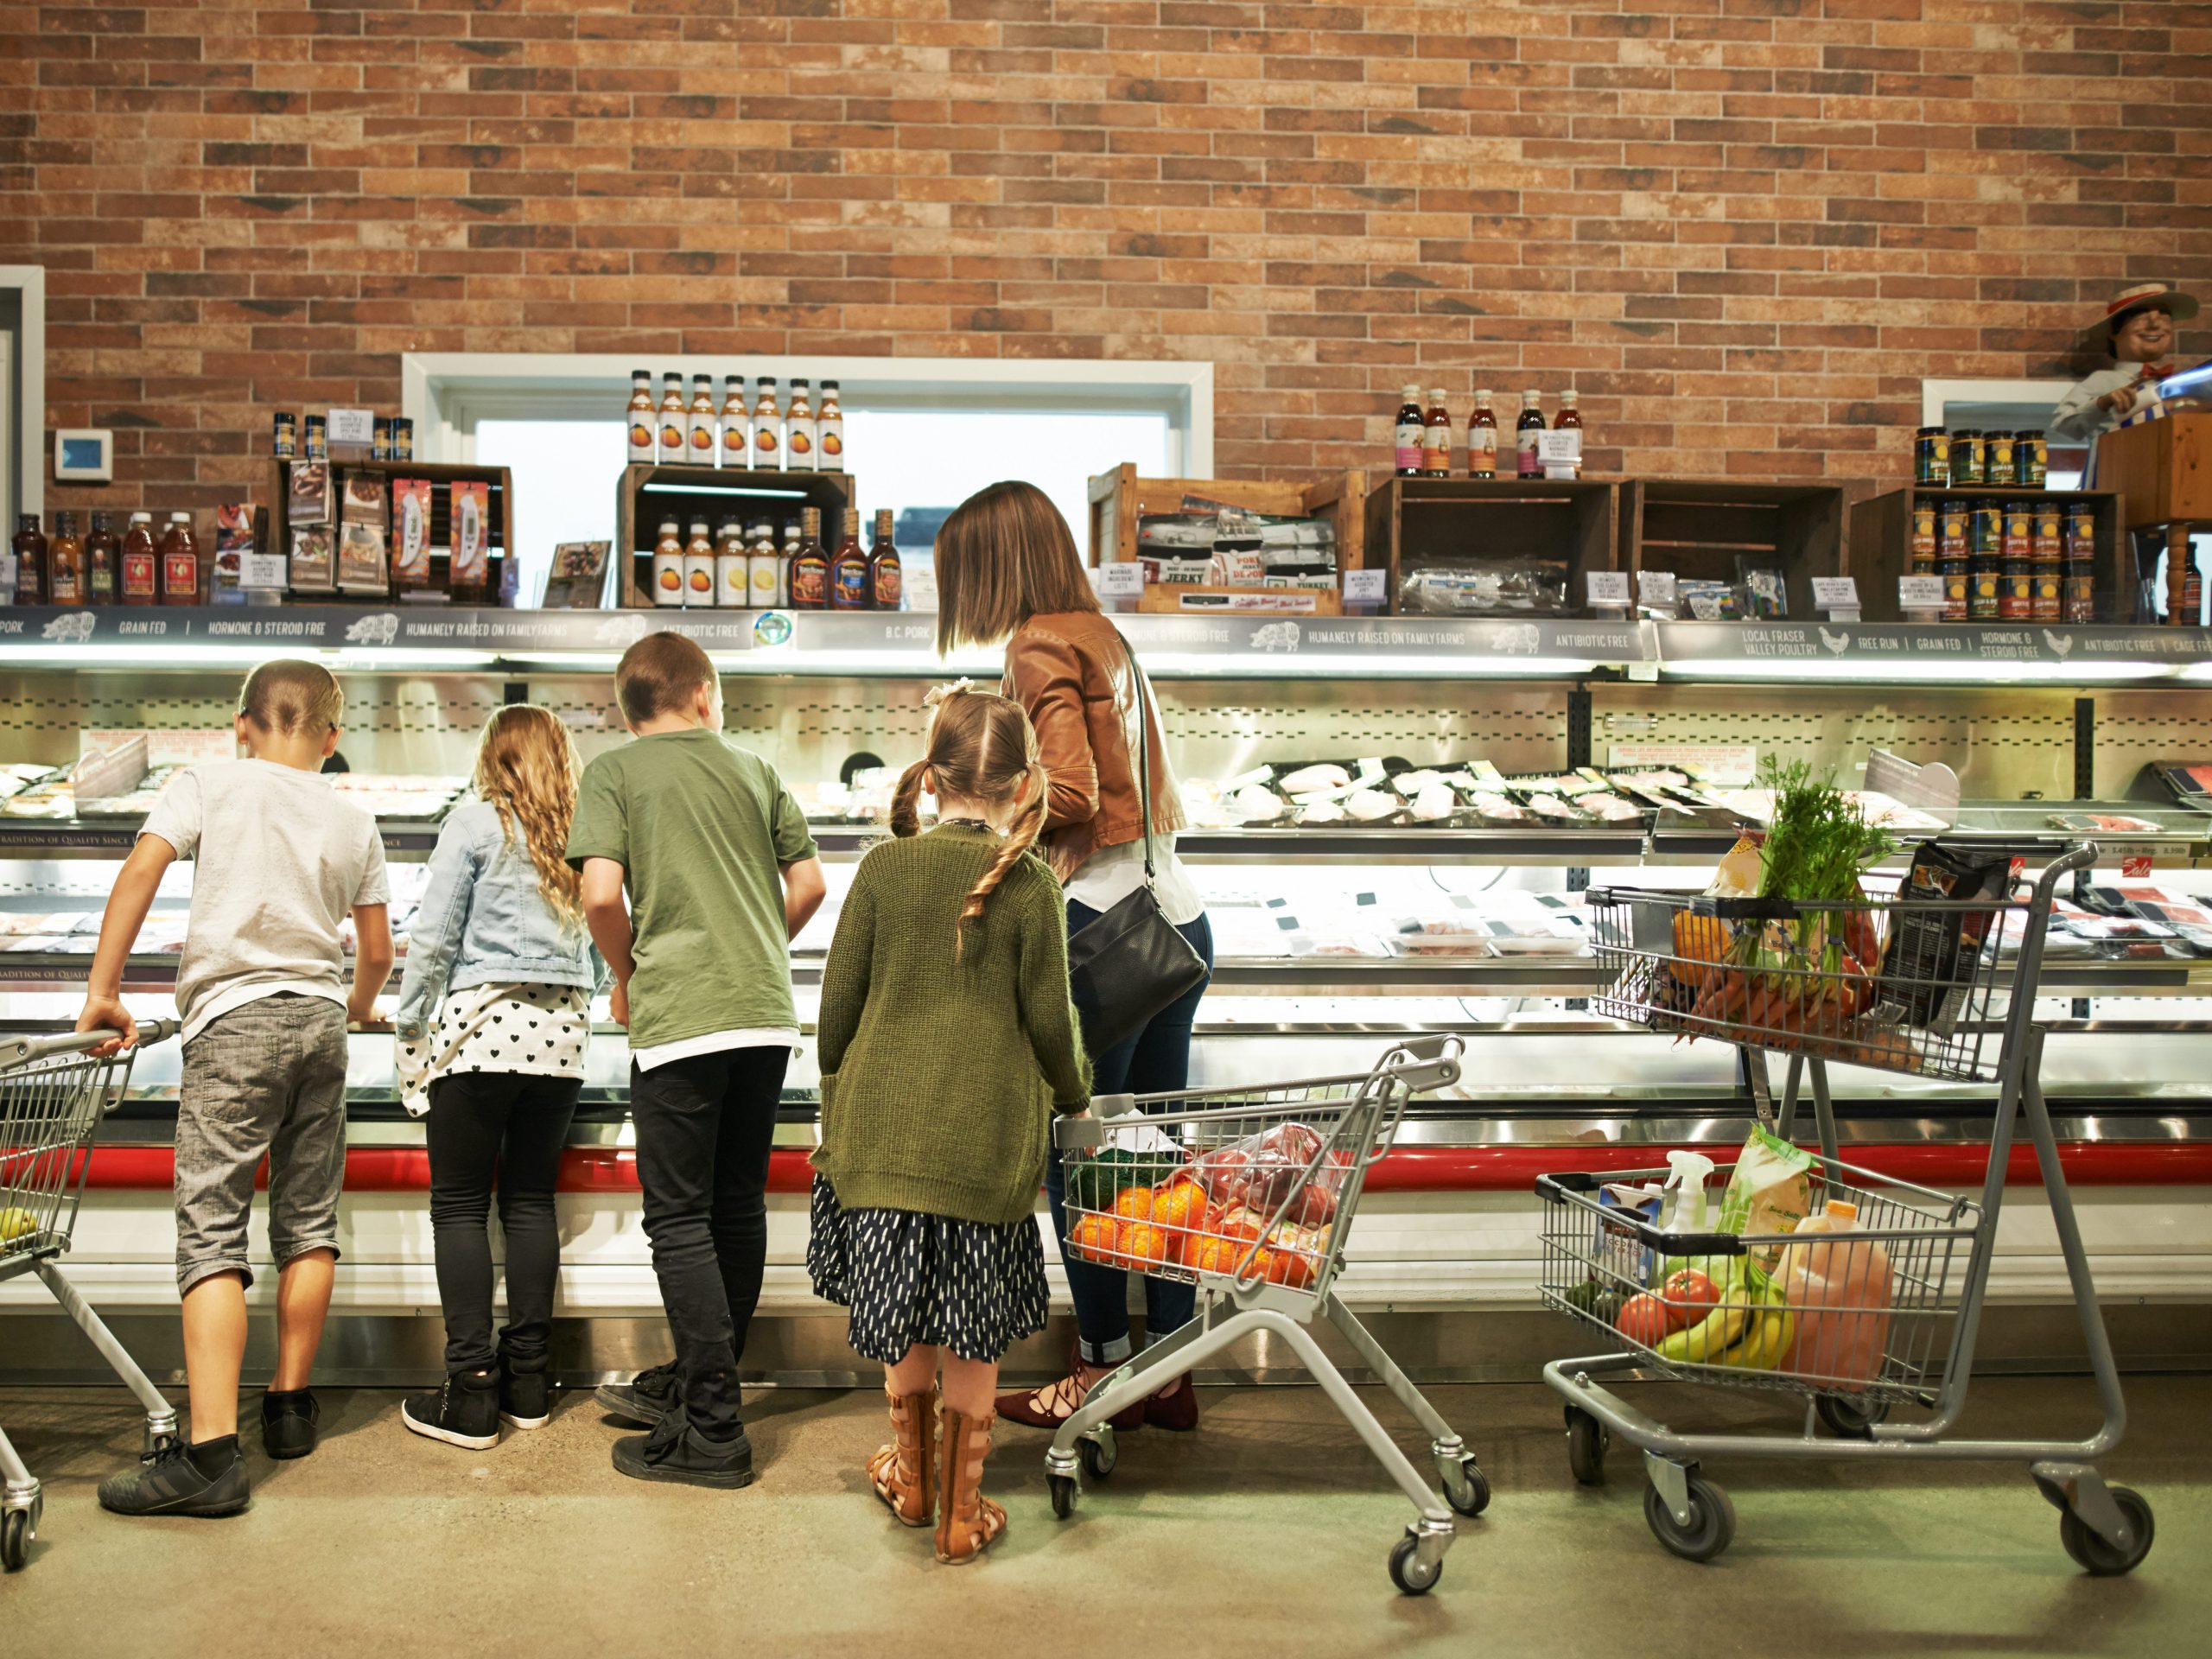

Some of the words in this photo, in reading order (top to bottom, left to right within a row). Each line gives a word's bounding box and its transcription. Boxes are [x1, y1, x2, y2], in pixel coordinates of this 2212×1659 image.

[1166, 574, 1204, 584] JERKY
[0, 620, 24, 633] PORK
[119, 621, 148, 634] GRAIN
[149, 621, 167, 635] FED
[208, 621, 252, 636] HORMONE
[255, 622, 261, 635] &
[264, 622, 302, 636] STEROID
[305, 622, 327, 636] FREE
[406, 623, 454, 637] HUMANELY
[456, 623, 489, 637] RAISED
[492, 623, 504, 637] ON
[505, 624, 537, 638] FAMILY
[537, 624, 568, 638] FARMS
[663, 624, 714, 638] ANTIBIOTIC
[716, 625, 739, 638] FREE
[885, 626, 902, 639] B.C.
[905, 626, 931, 639] PORK
[1210, 630, 1230, 644] FREE
[1308, 631, 1356, 645] HUMANELY
[1357, 632, 1389, 645] RAISED
[1391, 632, 1404, 645] ON
[1406, 632, 1436, 645] FAMILY
[1436, 632, 1465, 645] FARMS
[1556, 634, 1605, 648] ANTIBIOTIC
[1608, 634, 1629, 648] FREE
[1742, 630, 1770, 643] LOCAL
[1772, 631, 1805, 643] FRASER
[1981, 632, 2022, 645] HORMONE
[2025, 632, 2031, 644] &
[1745, 643, 1777, 656] VALLEY
[1778, 644, 1817, 657] POULTRY
[1859, 637, 1878, 650] FREE
[1879, 638, 1899, 650] RUN
[1916, 638, 1944, 651] GRAIN
[1945, 638, 1961, 651] FED
[2085, 639, 2133, 652] ANTIBIOTIC
[2133, 640, 2156, 653] FREE
[2173, 639, 2196, 652] CAGE
[1980, 645, 2017, 658] STEROID
[2018, 646, 2039, 658] FREE
[62, 835, 99, 846] QUALITY
[103, 836, 129, 844] SINCE
[2122, 858, 2151, 876] Sale
[44, 970, 55, 979] OF
[58, 969, 89, 981] QUALI
